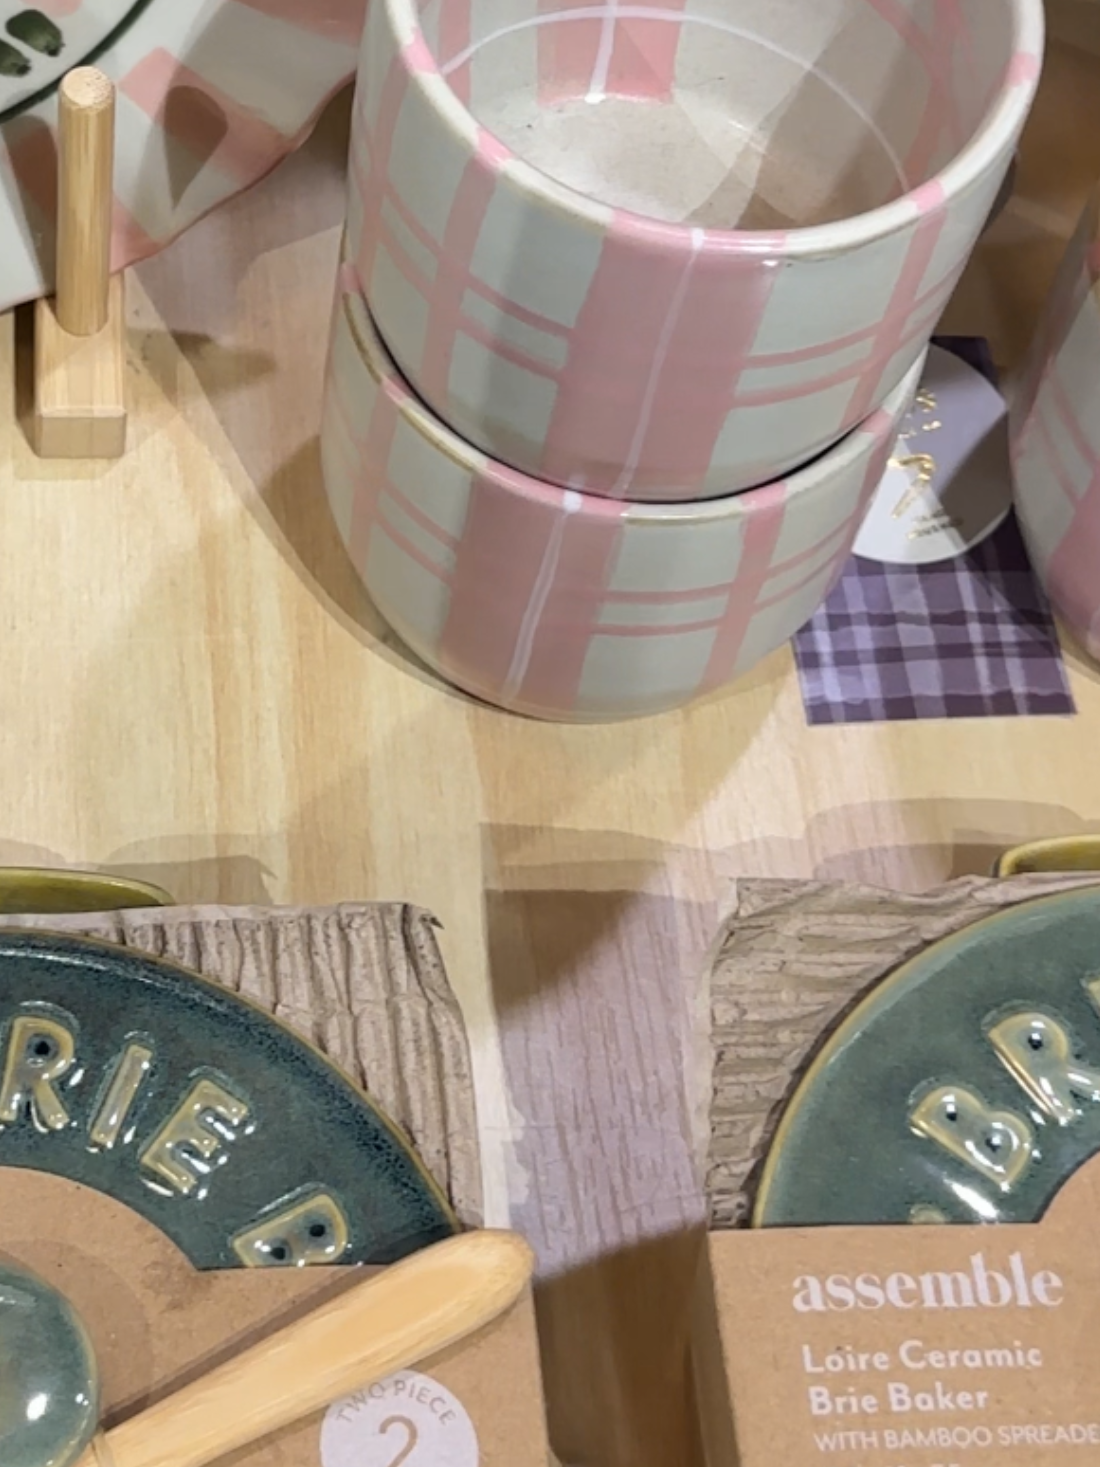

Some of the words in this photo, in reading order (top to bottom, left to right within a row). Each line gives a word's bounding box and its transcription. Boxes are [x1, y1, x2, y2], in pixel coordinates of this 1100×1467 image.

[792, 1251, 1064, 1312] assemble
[802, 1343, 890, 1373] Loire
[899, 1340, 1043, 1369] Ceramic
[336, 1382, 386, 1423] TWO
[393, 1380, 457, 1426] PIECE
[809, 1386, 879, 1415] Brie
[888, 1381, 989, 1412] Baker
[814, 1430, 878, 1451] WITH
[883, 1426, 993, 1449] BAMBOO
